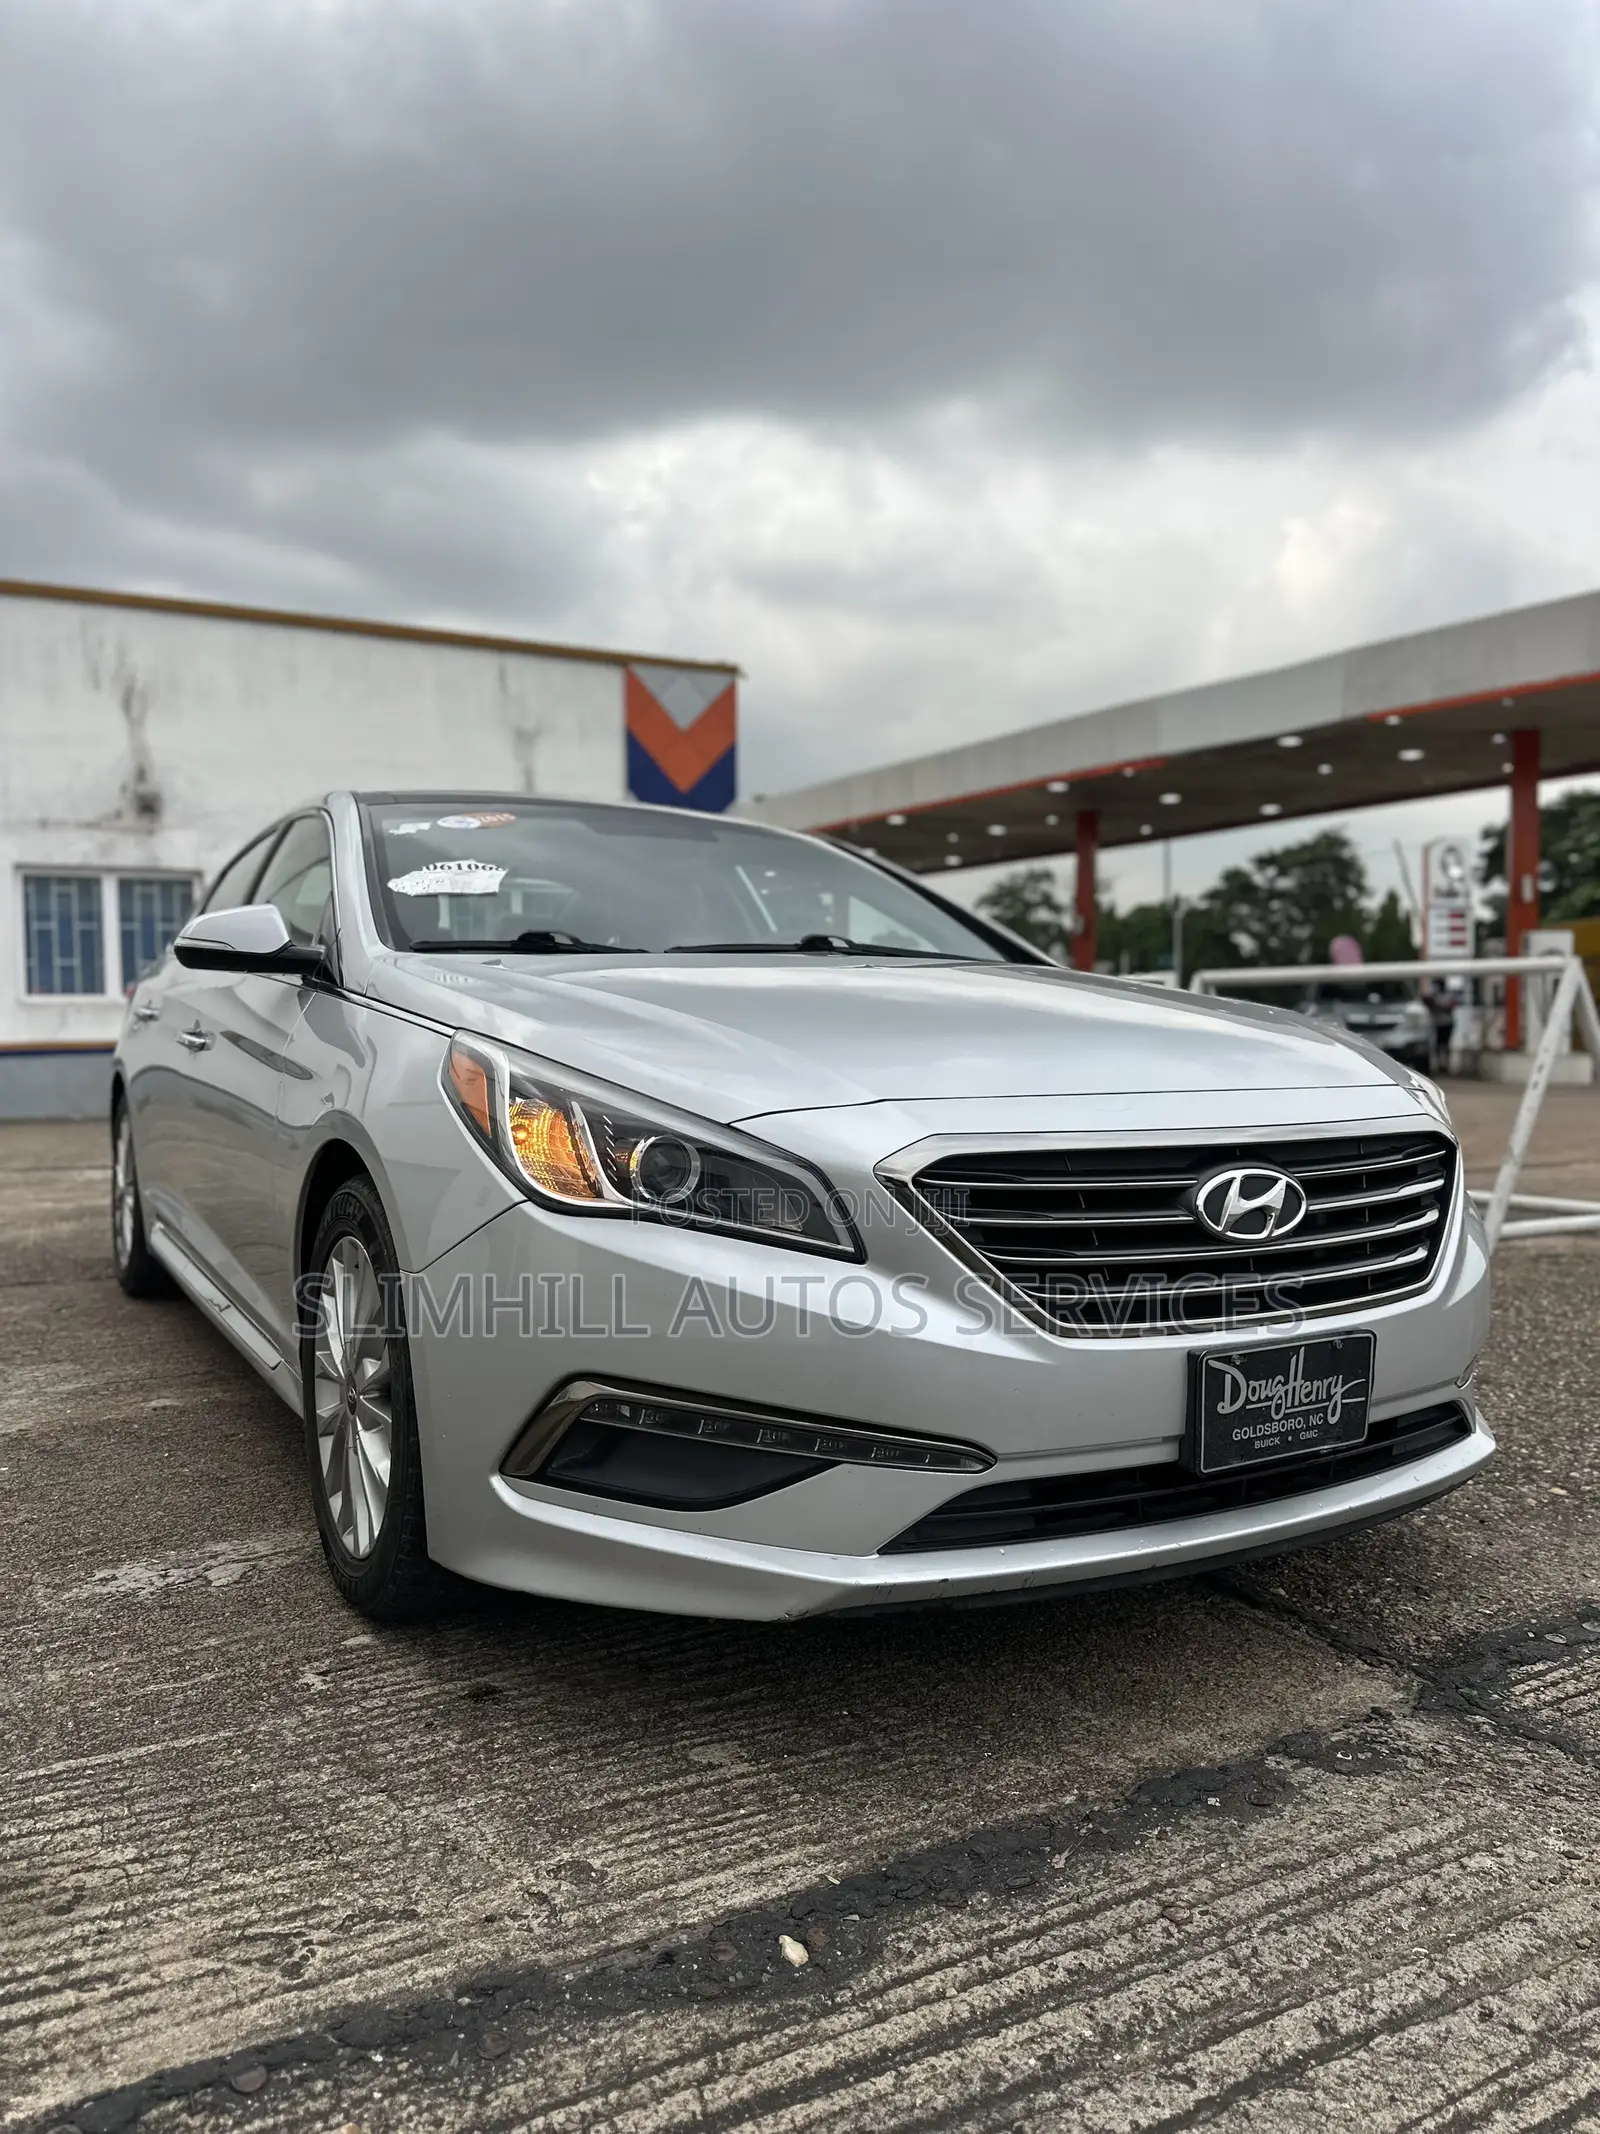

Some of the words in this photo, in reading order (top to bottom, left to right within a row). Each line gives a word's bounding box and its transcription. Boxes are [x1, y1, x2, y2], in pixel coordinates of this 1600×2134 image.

[1232, 1416, 1306, 1441] GOLDSBORO,
[1309, 1413, 1324, 1428] NC
[1254, 1436, 1281, 1449] BUICK
[1299, 1429, 1319, 1440] GMC
